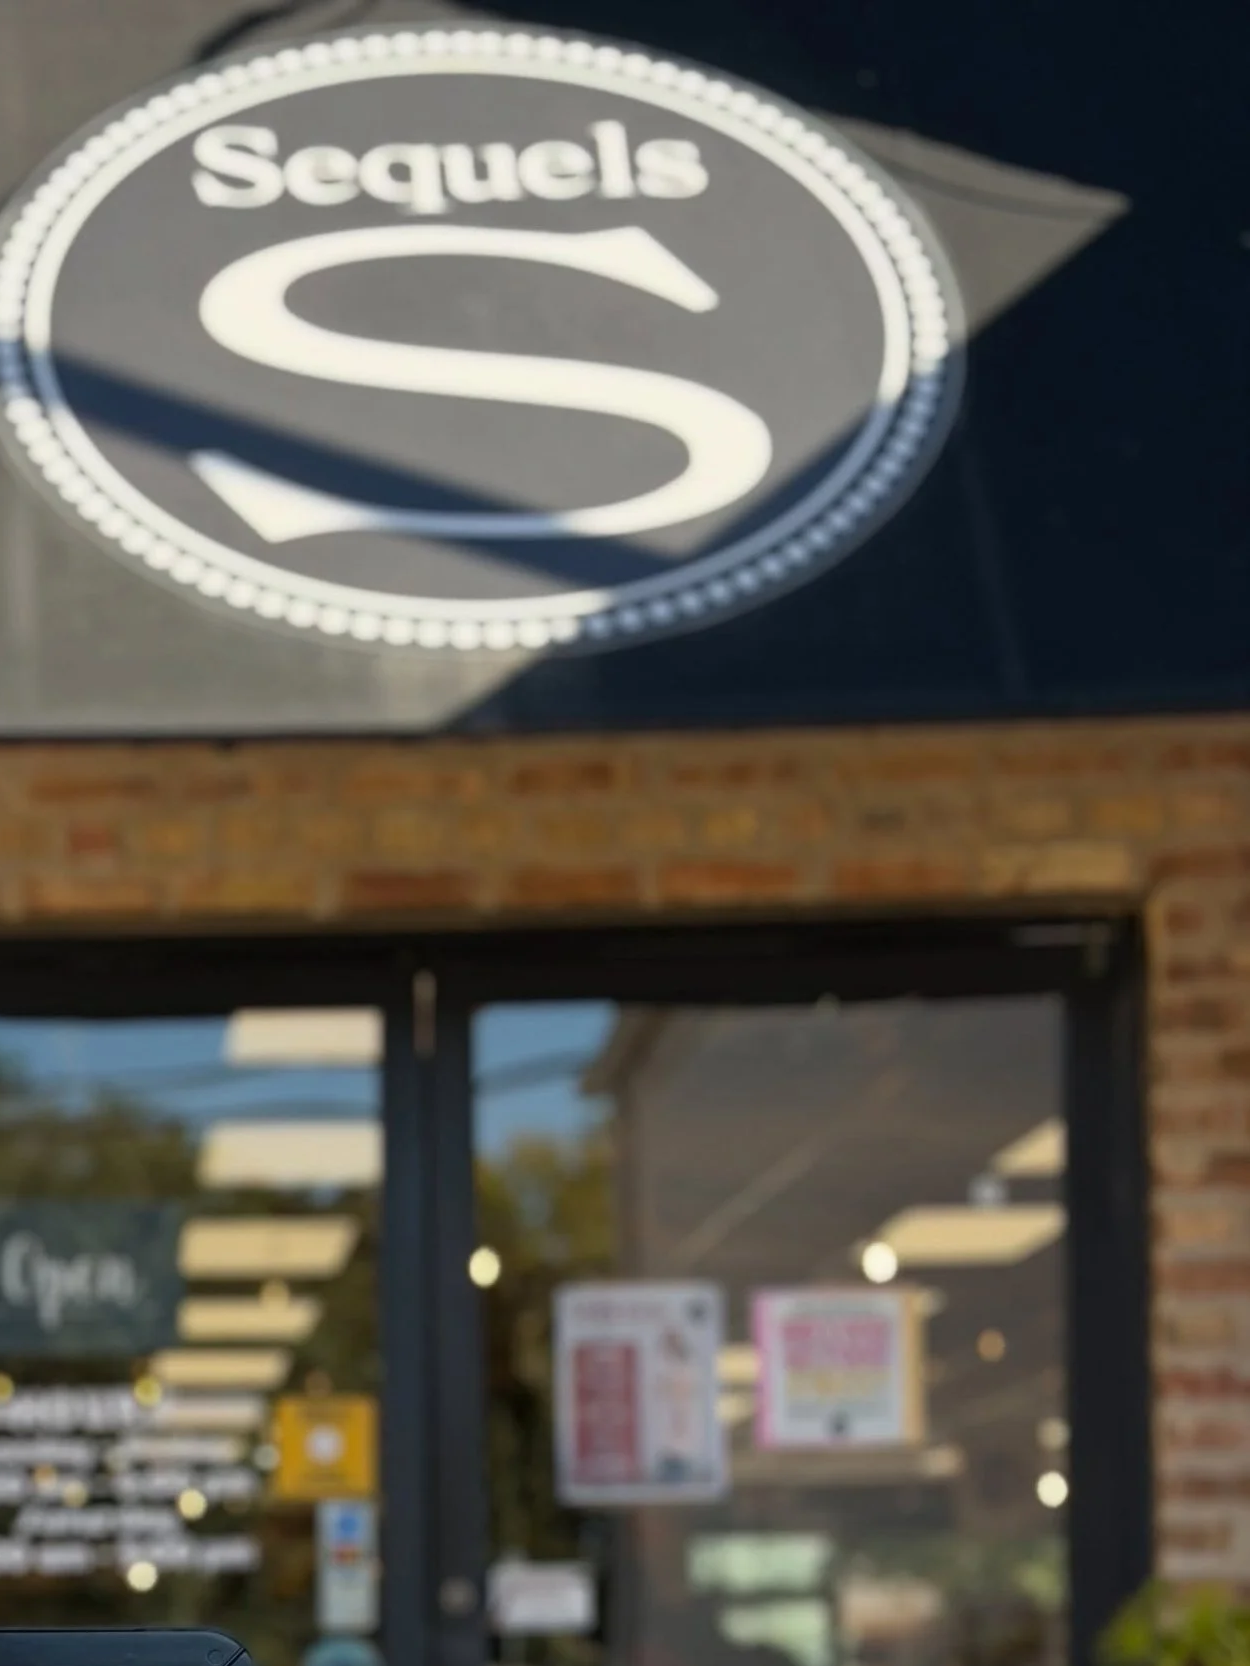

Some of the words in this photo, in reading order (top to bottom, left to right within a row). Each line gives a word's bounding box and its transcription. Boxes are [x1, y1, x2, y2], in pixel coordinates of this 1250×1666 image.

[192, 119, 710, 214] Sequels
[189, 224, 773, 544] S
[0, 1231, 136, 1331] Open
